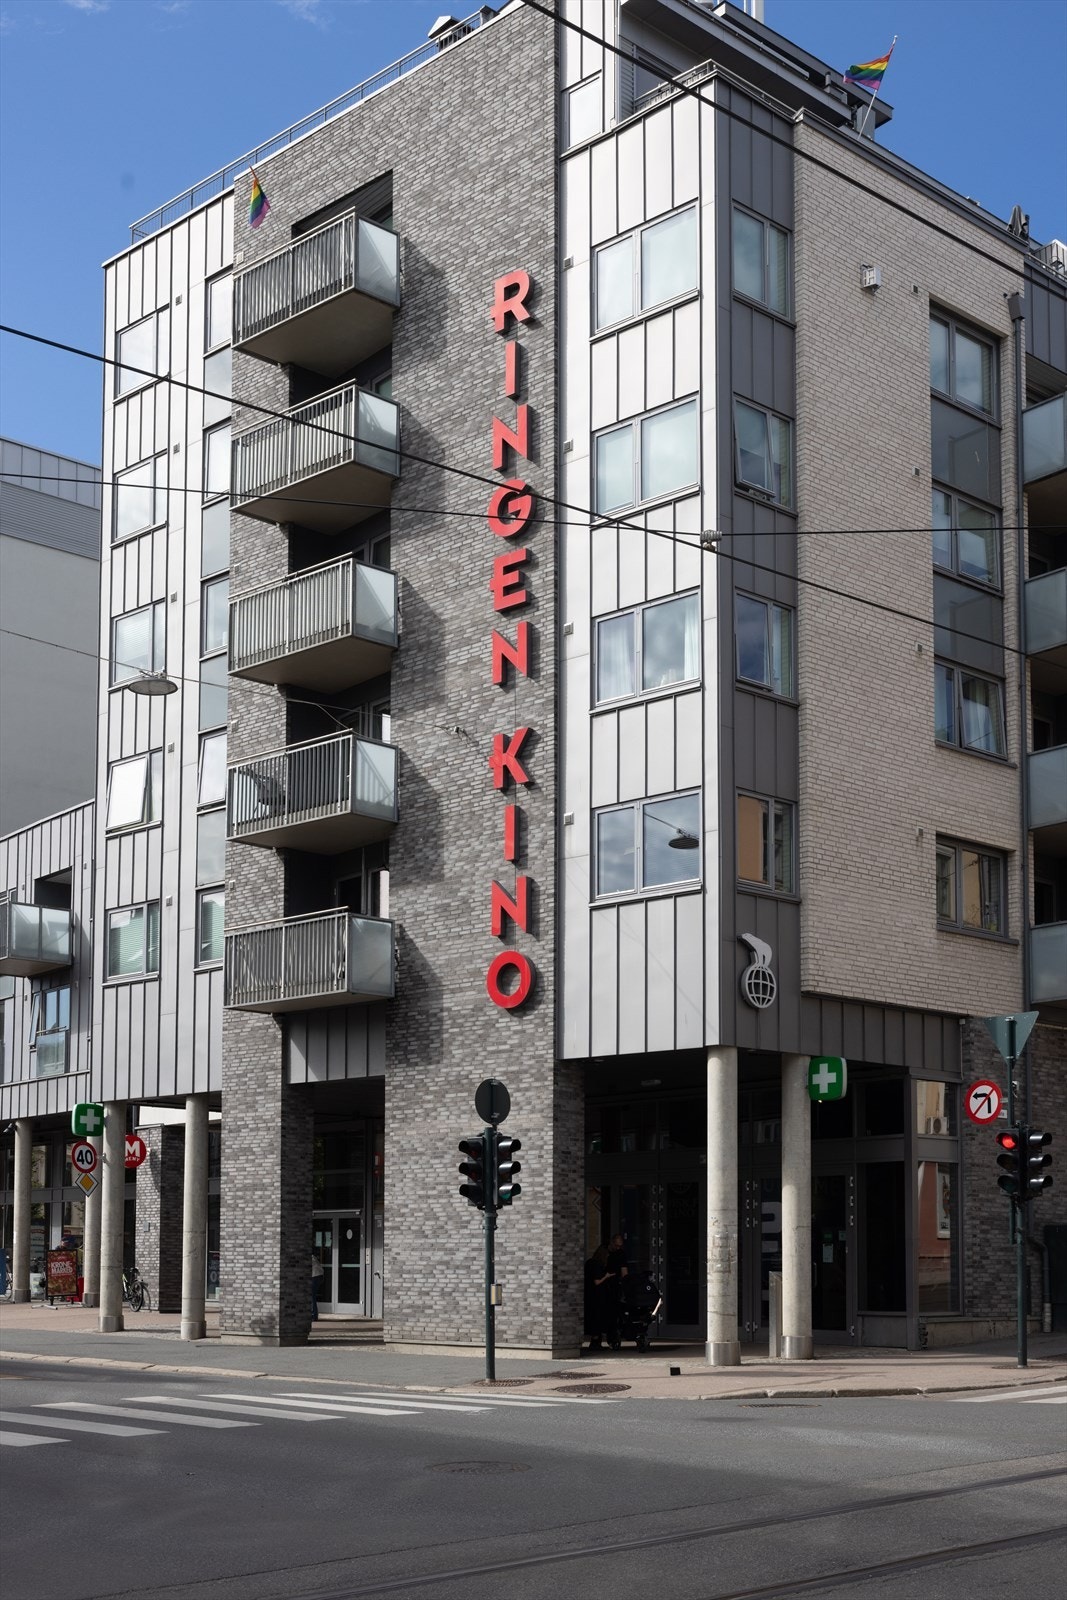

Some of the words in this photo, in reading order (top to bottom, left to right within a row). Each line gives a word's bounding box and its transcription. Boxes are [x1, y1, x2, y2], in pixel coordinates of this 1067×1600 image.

[488, 270, 533, 686] RINGEN
[487, 727, 533, 1009] KINO
[77, 1149, 93, 1165] 40
[125, 1140, 140, 1157] M
